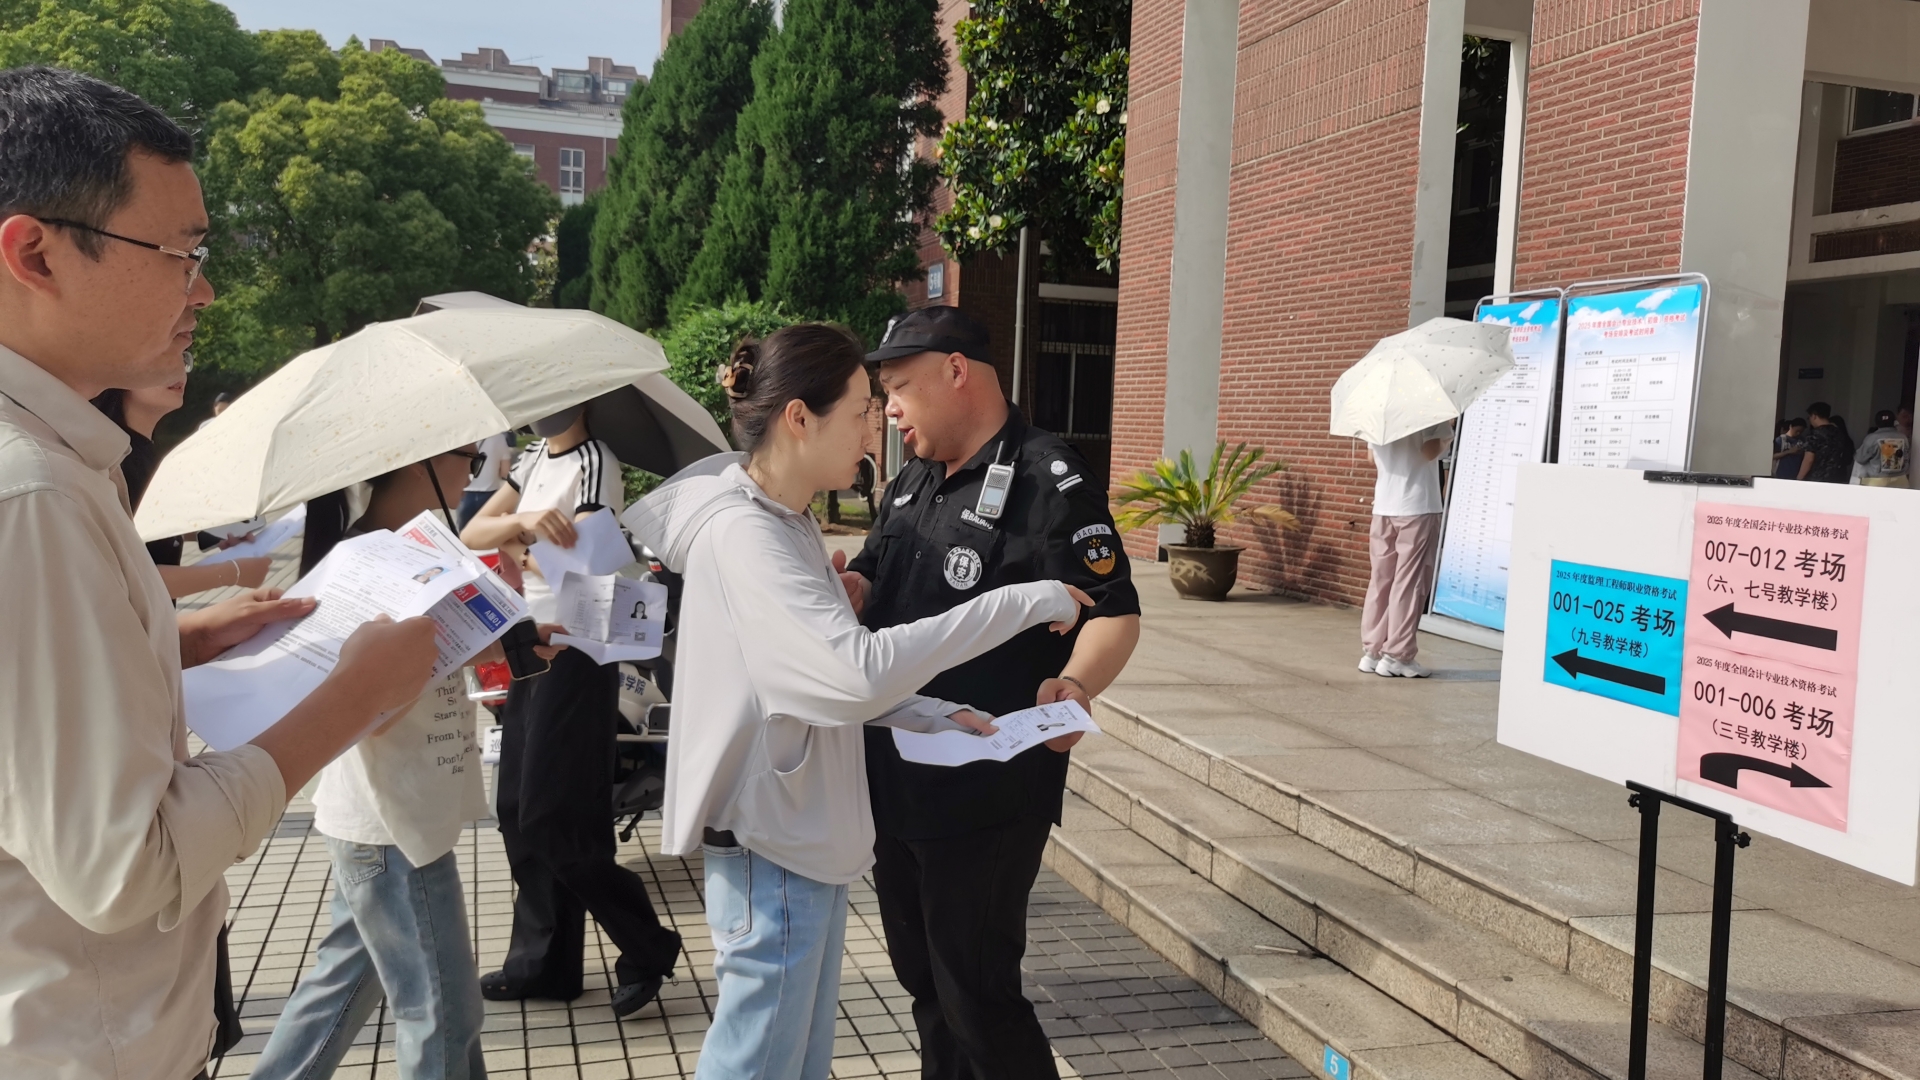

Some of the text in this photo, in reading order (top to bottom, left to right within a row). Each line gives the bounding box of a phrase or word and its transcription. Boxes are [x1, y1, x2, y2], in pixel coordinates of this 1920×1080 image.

[1707, 515, 1849, 540] 2025 年度全国会计专业技术资格考试
[1087, 546, 1111, 560] 保安
[1705, 540, 1847, 582] 007-012 考场
[1556, 570, 1677, 601] 2025 年度监理工程师职业资格考试
[1553, 591, 1676, 637] 001-025 考场
[1571, 627, 1649, 658] （九号教学楼）
[1696, 656, 1837, 698] 2025 年度全国会计专业技术资格考试
[434, 710, 457, 722] Stars
[1694, 681, 1834, 738] 001-006 考场
[427, 732, 455, 744] From
[1713, 719, 1808, 761] （三号教学楼）
[1330, 1054, 1339, 1075] 5
